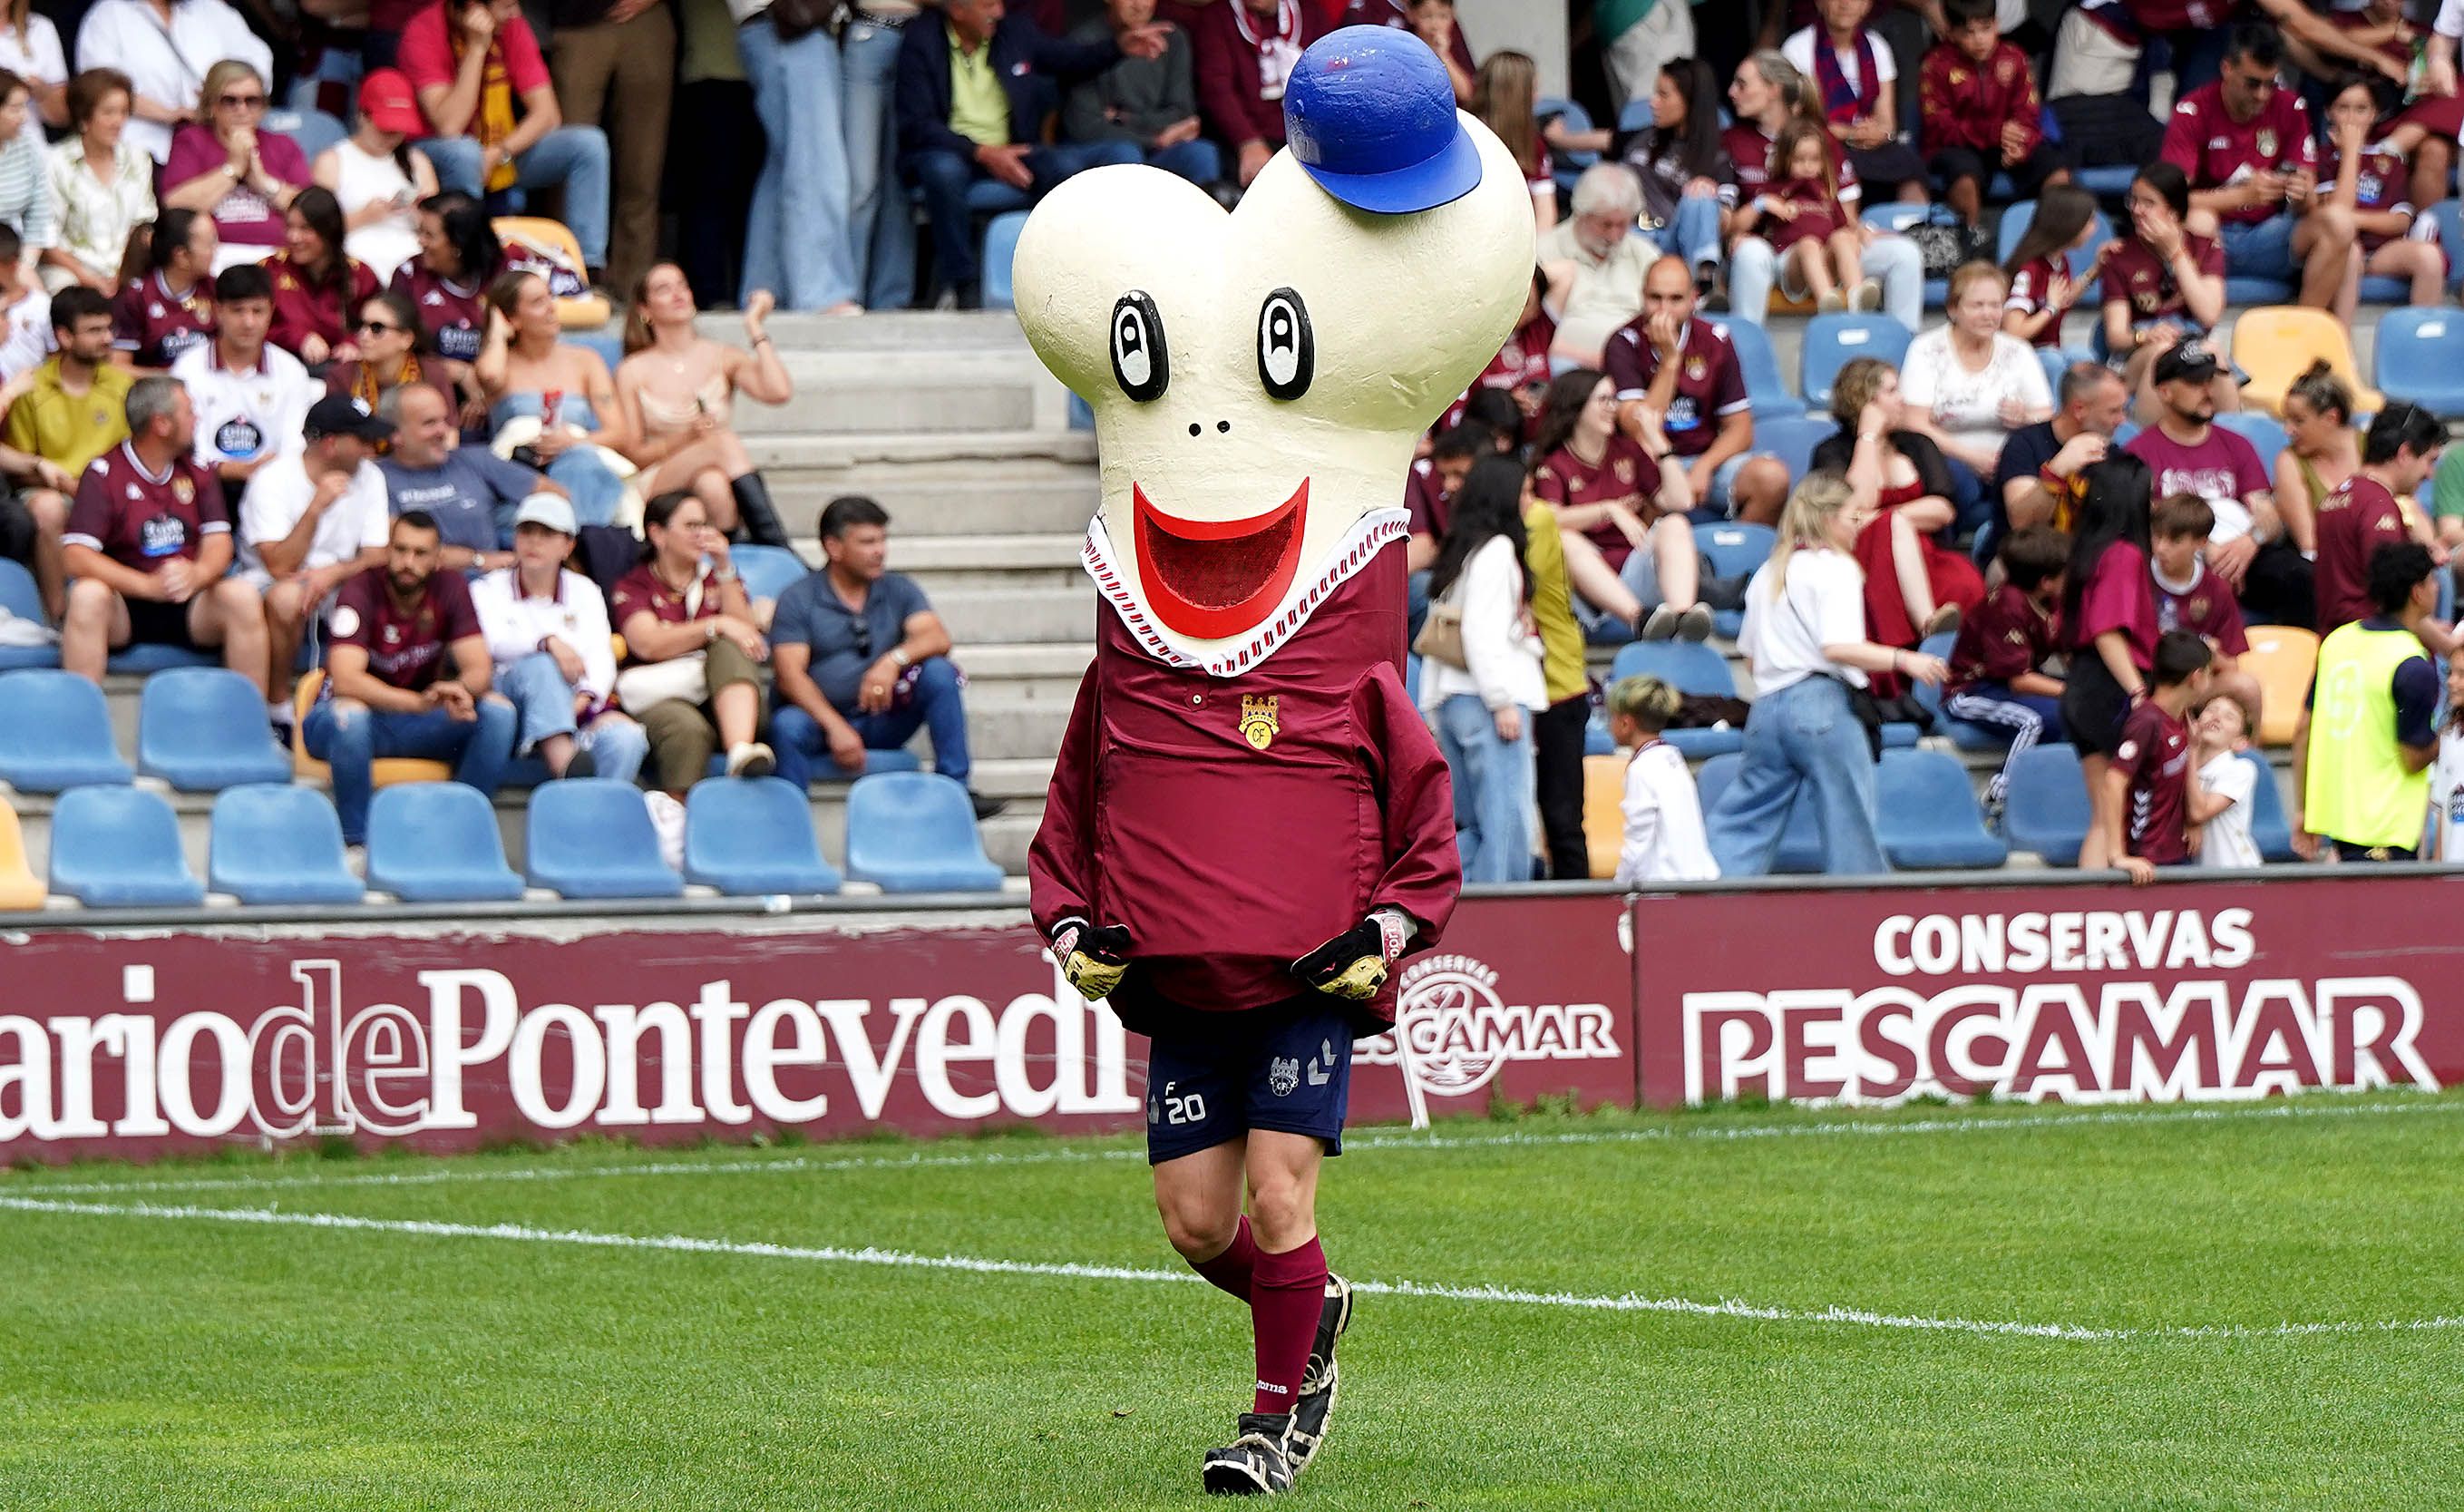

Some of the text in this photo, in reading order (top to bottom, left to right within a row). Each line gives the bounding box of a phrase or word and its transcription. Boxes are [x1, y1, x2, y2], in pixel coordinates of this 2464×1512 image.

[1252, 728, 1265, 742] CF
[1874, 908, 2255, 976] CONSERVAS
[1682, 975, 2443, 1108] PESCAMAR
[1165, 1081, 1176, 1097] F
[1164, 1093, 1206, 1125] 20
